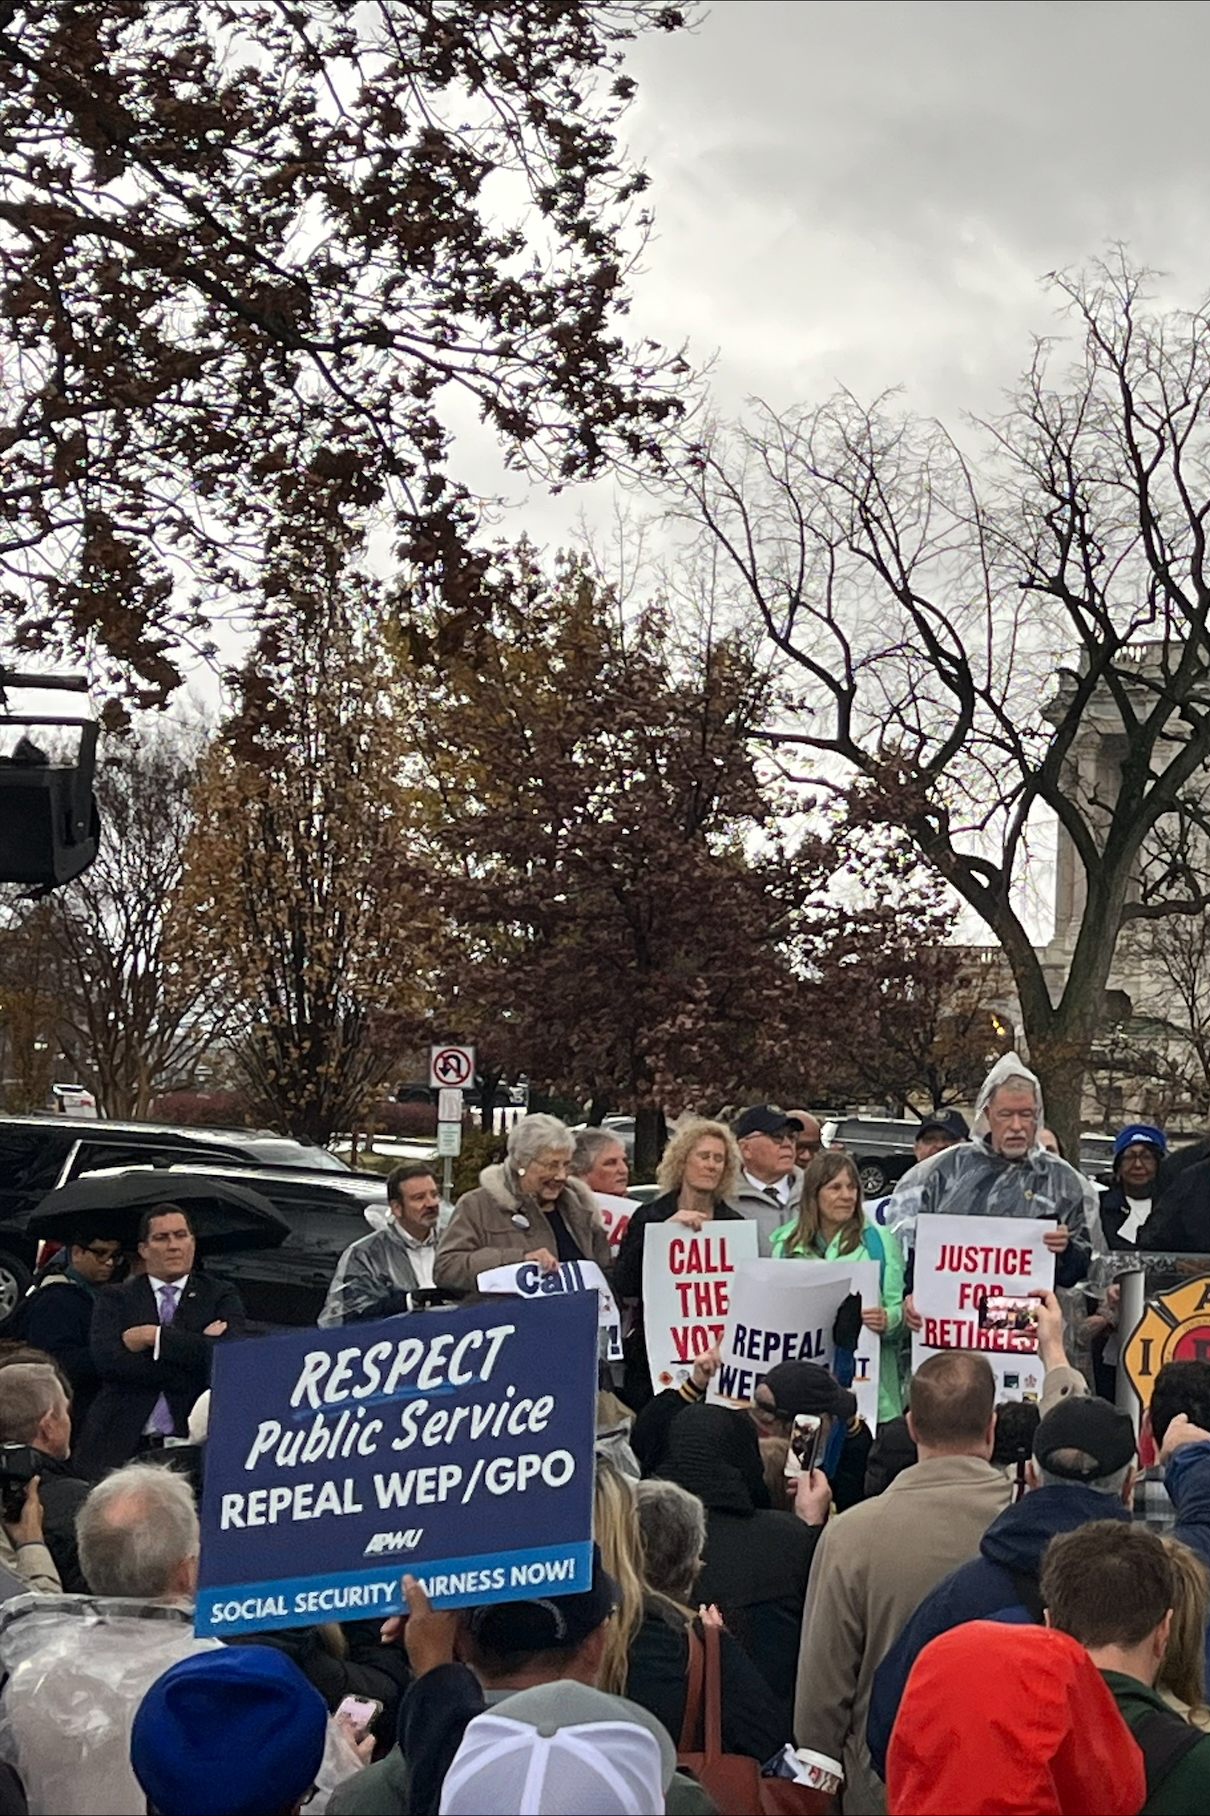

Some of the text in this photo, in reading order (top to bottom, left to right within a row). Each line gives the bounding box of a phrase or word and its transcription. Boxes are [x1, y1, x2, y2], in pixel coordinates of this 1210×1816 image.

[516, 1255, 588, 1295] Call
[669, 1237, 735, 1275] CALL
[935, 1244, 1033, 1276] JUSTICE
[675, 1280, 730, 1318] THE
[670, 1324, 725, 1362] VOT
[732, 1324, 826, 1362] REPEAL
[290, 1325, 515, 1410] RESPECT
[245, 1385, 554, 1471] Public Service
[220, 1450, 575, 1530] REPEAL WEP/GPO
[363, 1529, 424, 1554] APWU
[210, 1596, 288, 1624] SOCIAL
[294, 1580, 398, 1613] SECURITY
[511, 1558, 576, 1587] NOW!
